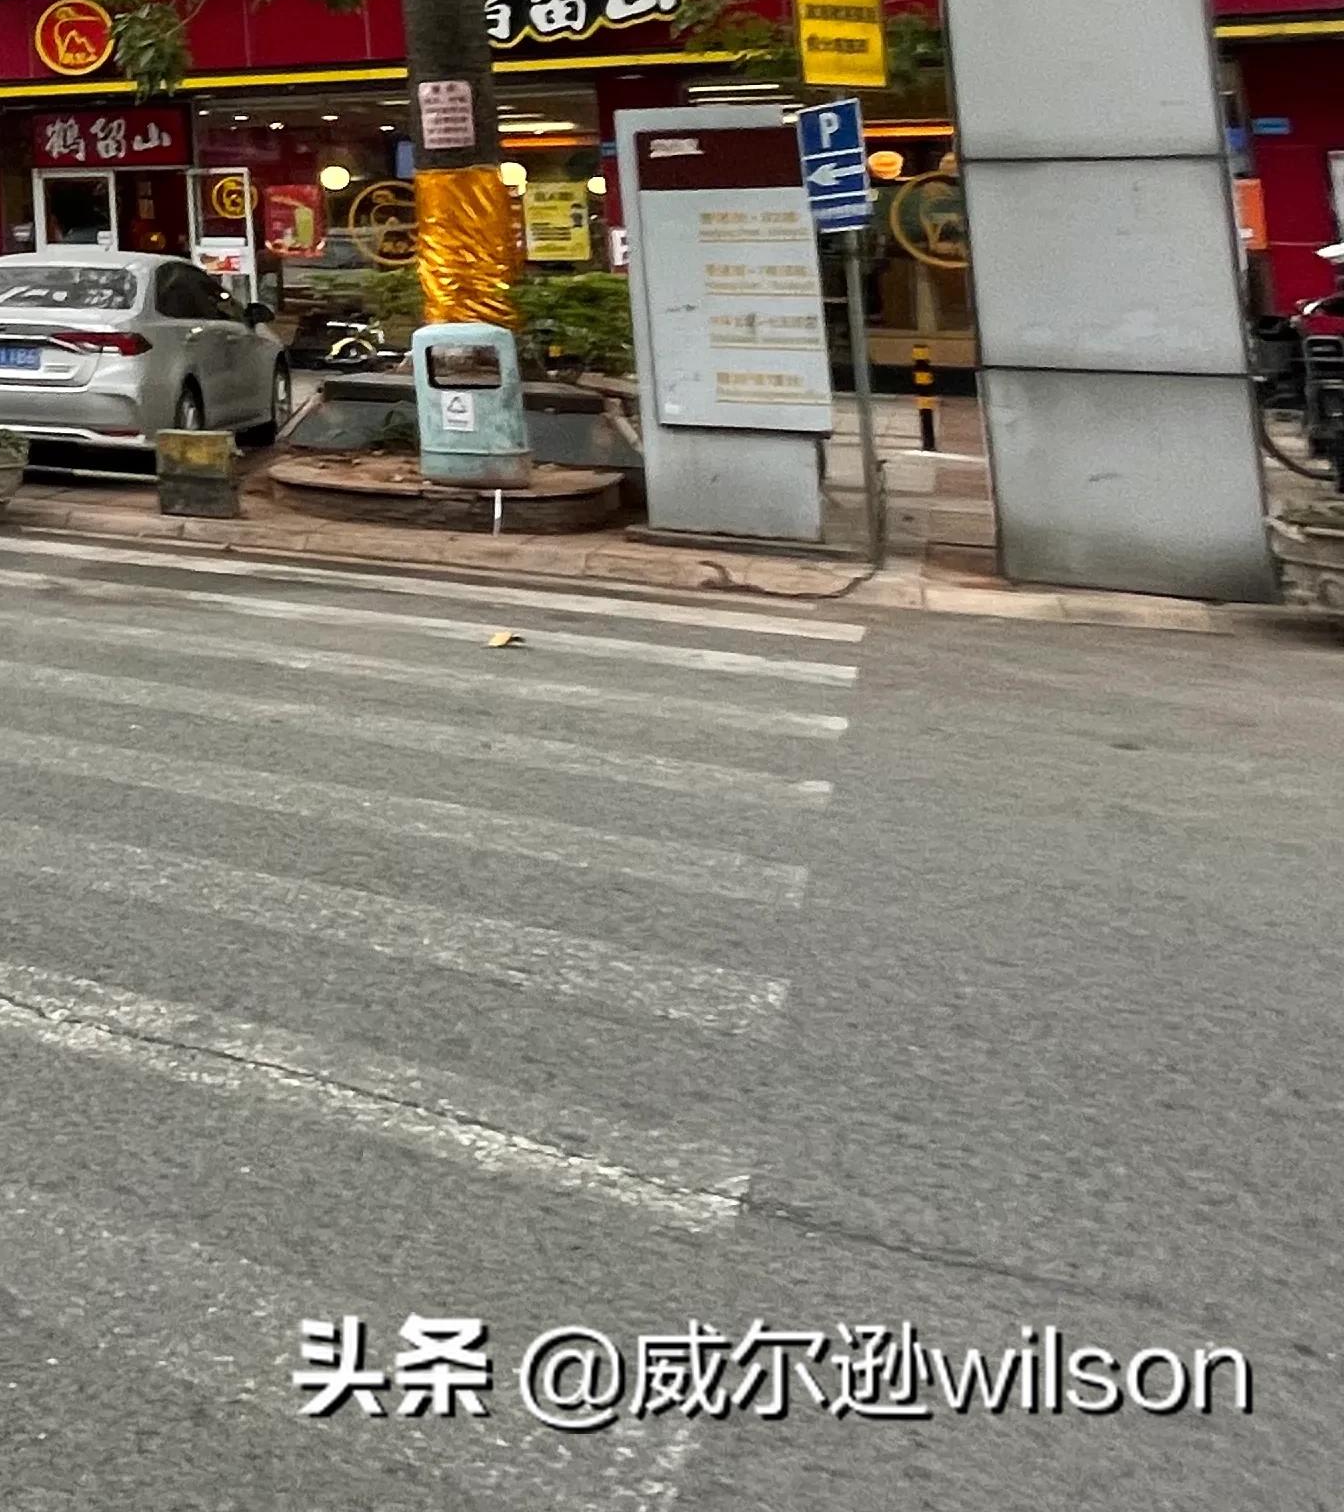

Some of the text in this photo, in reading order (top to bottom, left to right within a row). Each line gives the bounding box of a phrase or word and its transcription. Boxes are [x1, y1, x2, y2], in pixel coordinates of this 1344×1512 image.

[45, 117, 172, 161] 鹤留山
[819, 112, 838, 148] P
